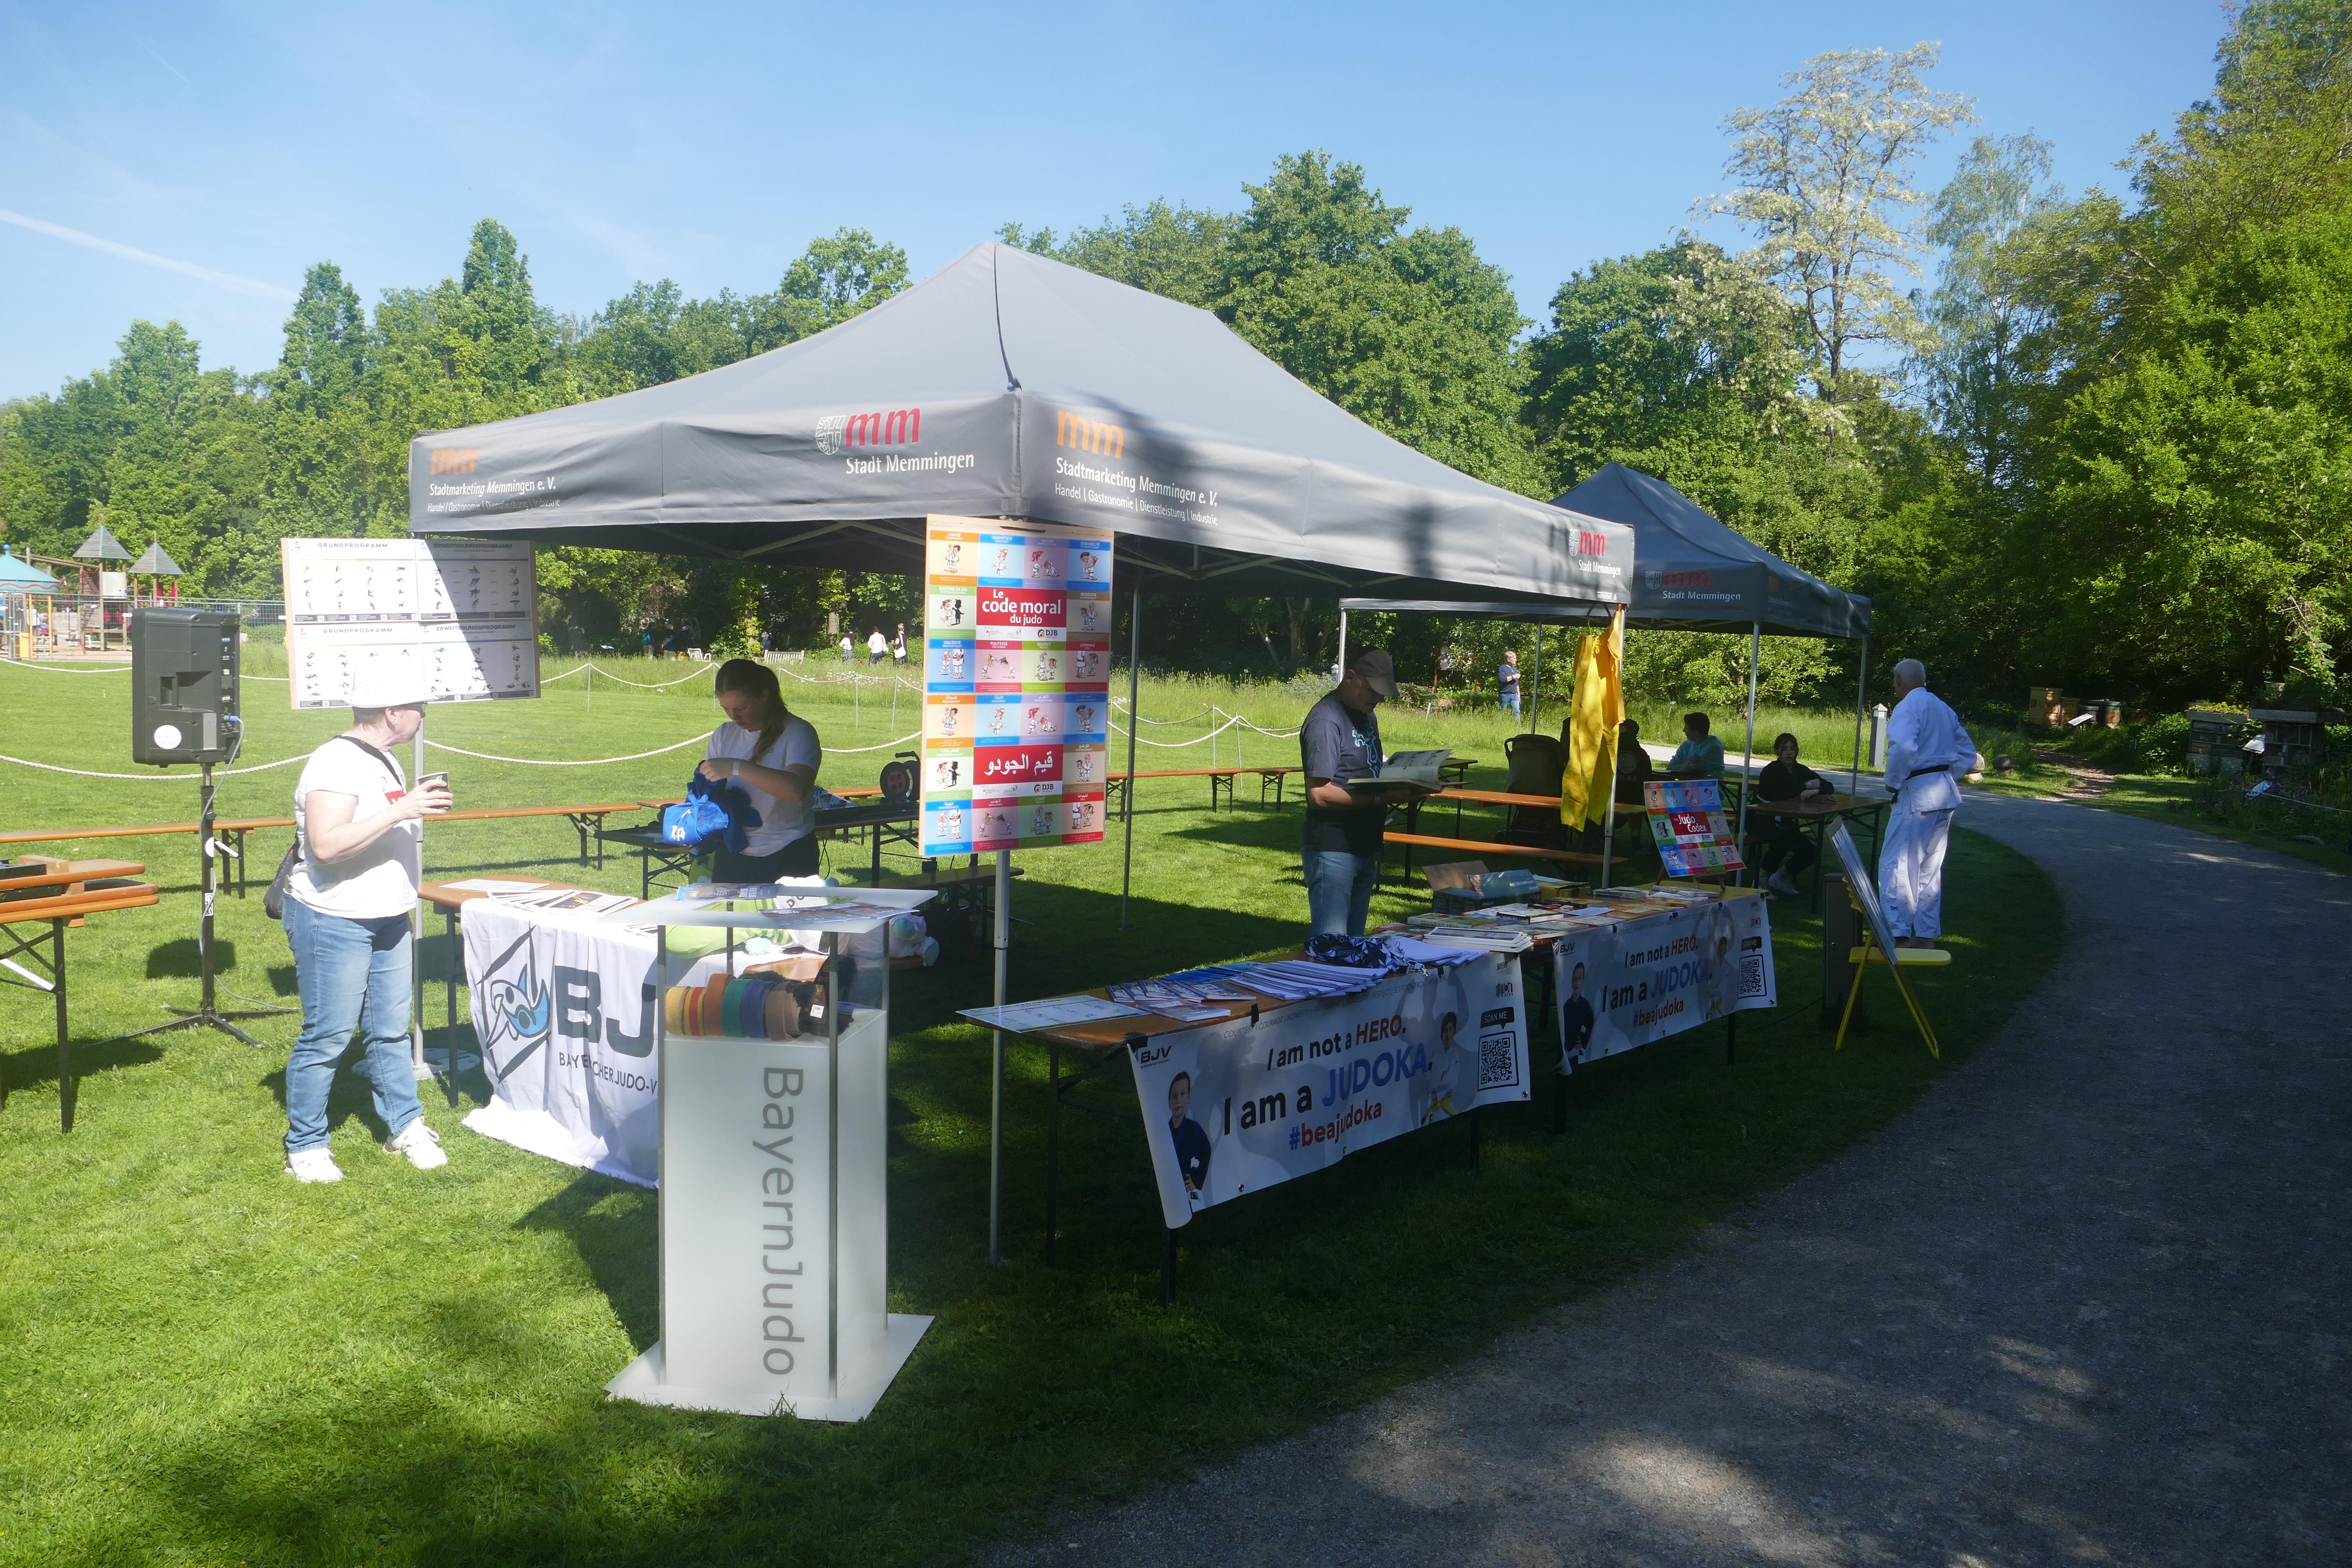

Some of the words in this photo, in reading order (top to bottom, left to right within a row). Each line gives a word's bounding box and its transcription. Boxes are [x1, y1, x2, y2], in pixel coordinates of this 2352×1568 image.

[845, 408, 921, 447] mm
[1057, 410, 1124, 459] mm
[845, 456, 882, 474] Stadt
[886, 451, 974, 474] Memmingen
[429, 482, 485, 497] Stadtmarketing
[486, 479, 535, 495] Memmingen
[537, 481, 545, 490] e.
[547, 476, 557, 490] V.
[1056, 457, 1136, 493] Stadtmarketing
[1139, 475, 1196, 503] Memmingen
[1198, 492, 1206, 504] e.
[1209, 490, 1218, 506] V.
[427, 502, 445, 512] Handel
[448, 502, 481, 512] Gastronomie
[485, 499, 528, 511] Dienstleistung
[532, 497, 560, 508] Industrie
[1055, 483, 1081, 499] Handel
[1088, 490, 1133, 509] Gastronomie
[1139, 499, 1185, 522] Dienstleistung
[1190, 510, 1218, 526] Industrie
[1579, 531, 1606, 557] mm
[1578, 559, 1592, 573] Stadt
[1592, 561, 1621, 578] Memmingen
[1664, 571, 1710, 588] mm
[981, 597, 1017, 613] code
[1020, 599, 1061, 614] moral
[992, 589, 1004, 599] Le
[1662, 590, 1685, 599] Stadt
[1687, 591, 1741, 602] Memmingen
[1009, 613, 1021, 624] du
[1023, 614, 1042, 626] judo
[984, 753, 1029, 776] الجودو
[1034, 751, 1054, 777] قيم
[1678, 813, 1696, 825] Judo
[1687, 824, 1707, 833] Codex
[1560, 942, 1575, 953] BJV
[1624, 951, 1629, 968] I
[1629, 951, 1644, 967] am
[1647, 945, 1663, 963] not
[1665, 945, 1669, 959] a
[1671, 934, 1699, 956] HERO.
[1602, 985, 1608, 1012] I
[1610, 985, 1634, 1010] am
[1638, 981, 1648, 1002] a
[1651, 957, 1713, 998] JUDOKA.
[1224, 1025, 1255, 1039] COURTESY
[1258, 1015, 1283, 1030] COURAGE
[1286, 1009, 1310, 1022] HONESTY
[1371, 989, 1391, 999] RESPECT
[1393, 981, 1426, 995] SELFCONTROL
[1484, 1014, 1498, 1023] SCAN
[1499, 1011, 1507, 1020] ME
[1633, 997, 1684, 1028] #beajudoka
[1140, 1045, 1172, 1064] BJV
[1267, 1047, 1274, 1071] I
[1277, 1044, 1304, 1067] am
[1310, 1032, 1341, 1059] not
[1345, 1032, 1352, 1050] a
[1356, 1014, 1406, 1046] HERO.
[559, 1052, 614, 1083] BAYECHER
[614, 1070, 659, 1096] JUDO-V
[1224, 1097, 1231, 1136] I
[1240, 1091, 1286, 1130] am
[1296, 1085, 1312, 1113] a
[1322, 1042, 1433, 1107] JUDOKA.
[1289, 1099, 1382, 1151] #beajudoka
[752, 1067, 805, 1376] BayernJudo
